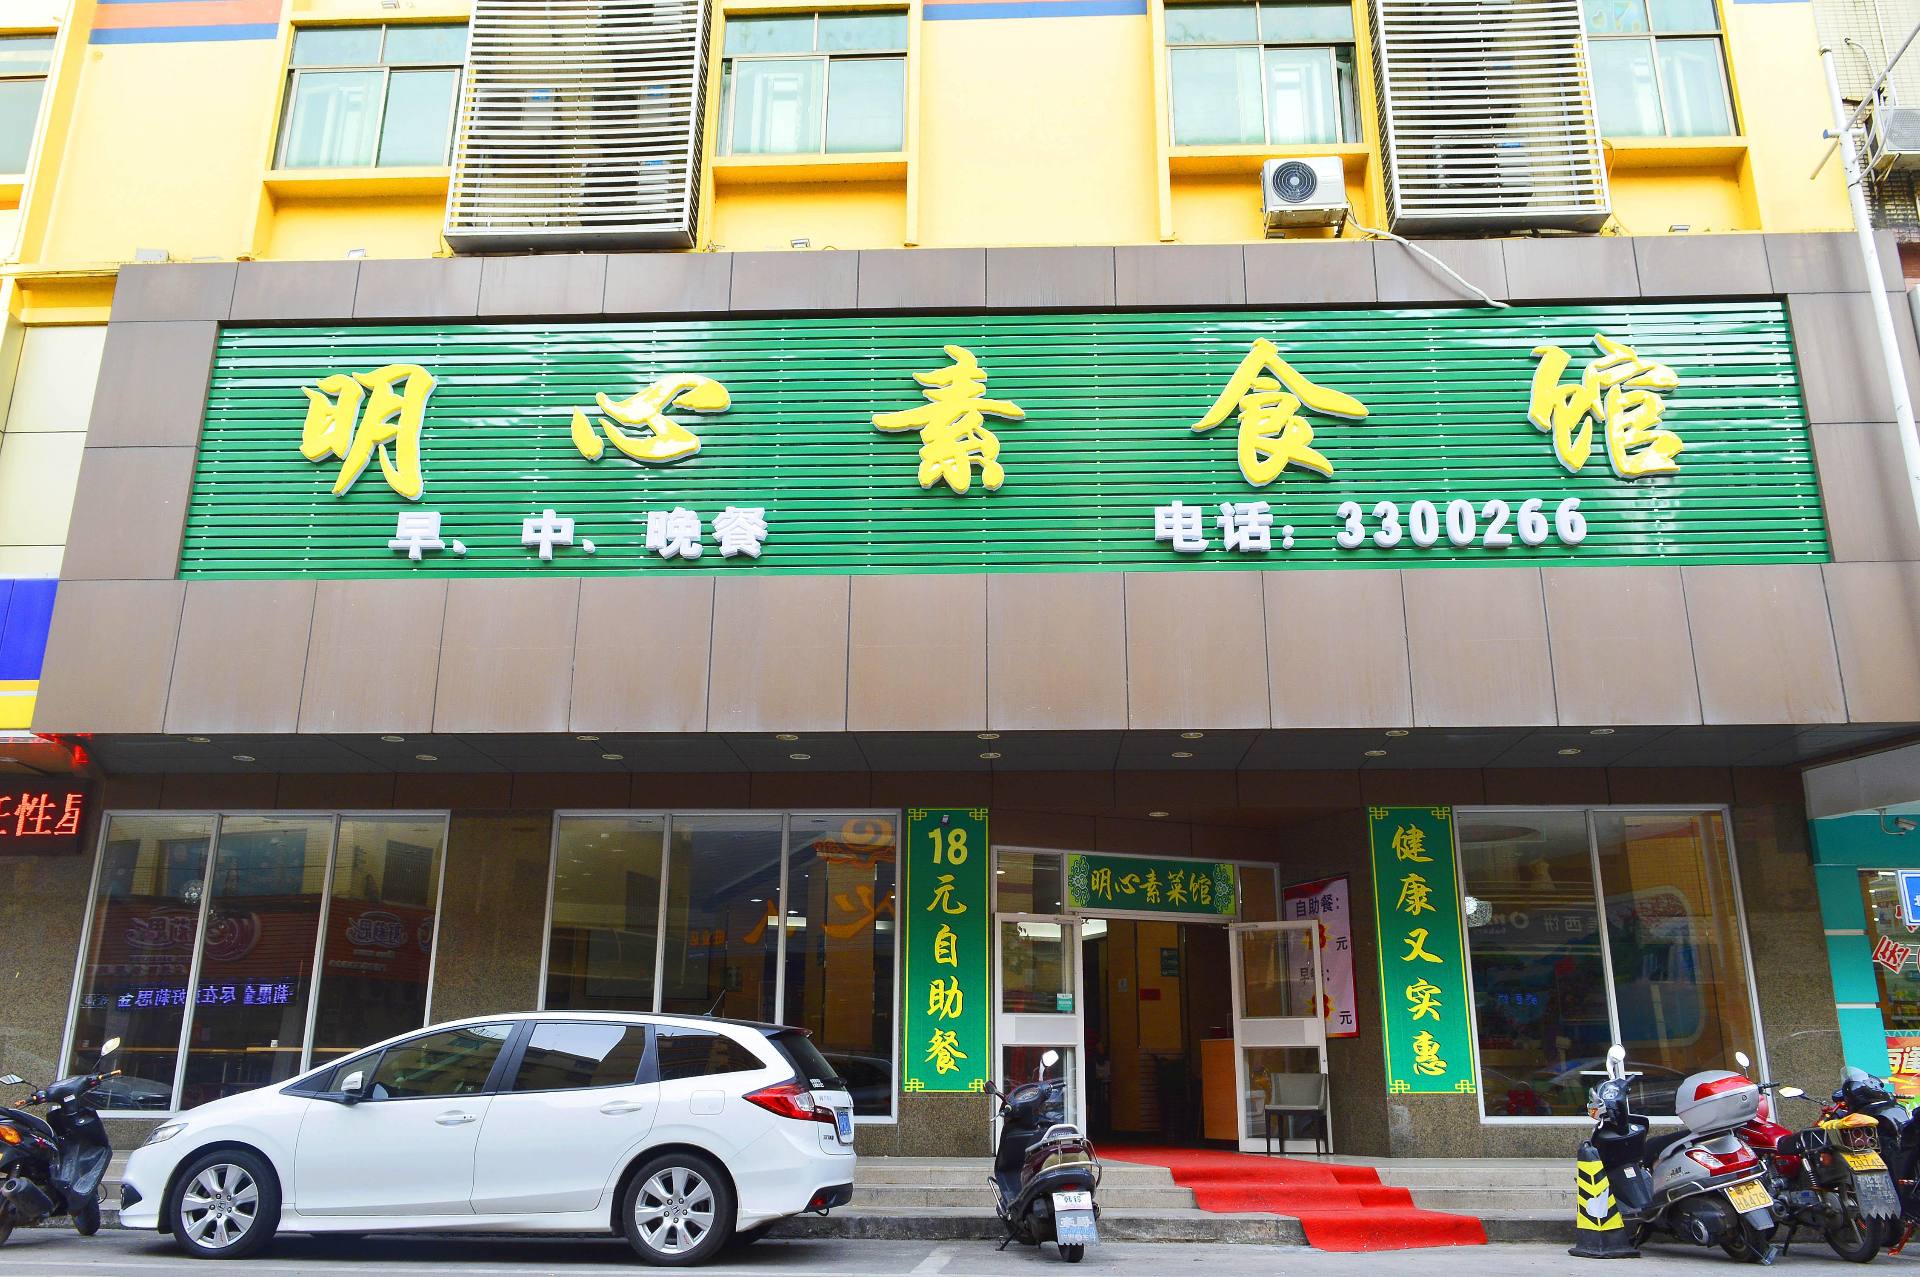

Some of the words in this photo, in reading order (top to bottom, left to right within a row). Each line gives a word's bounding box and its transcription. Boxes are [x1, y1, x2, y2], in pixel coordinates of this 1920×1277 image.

[299, 333, 1684, 500] 明心素食馆
[1336, 497, 1588, 549] 3300266
[1090, 867, 1213, 907] 明心素菜馆
[1335, 936, 1349, 951] 元
[1391, 823, 1448, 1077] 健康又实惠
[1339, 1010, 1353, 1025] 元
